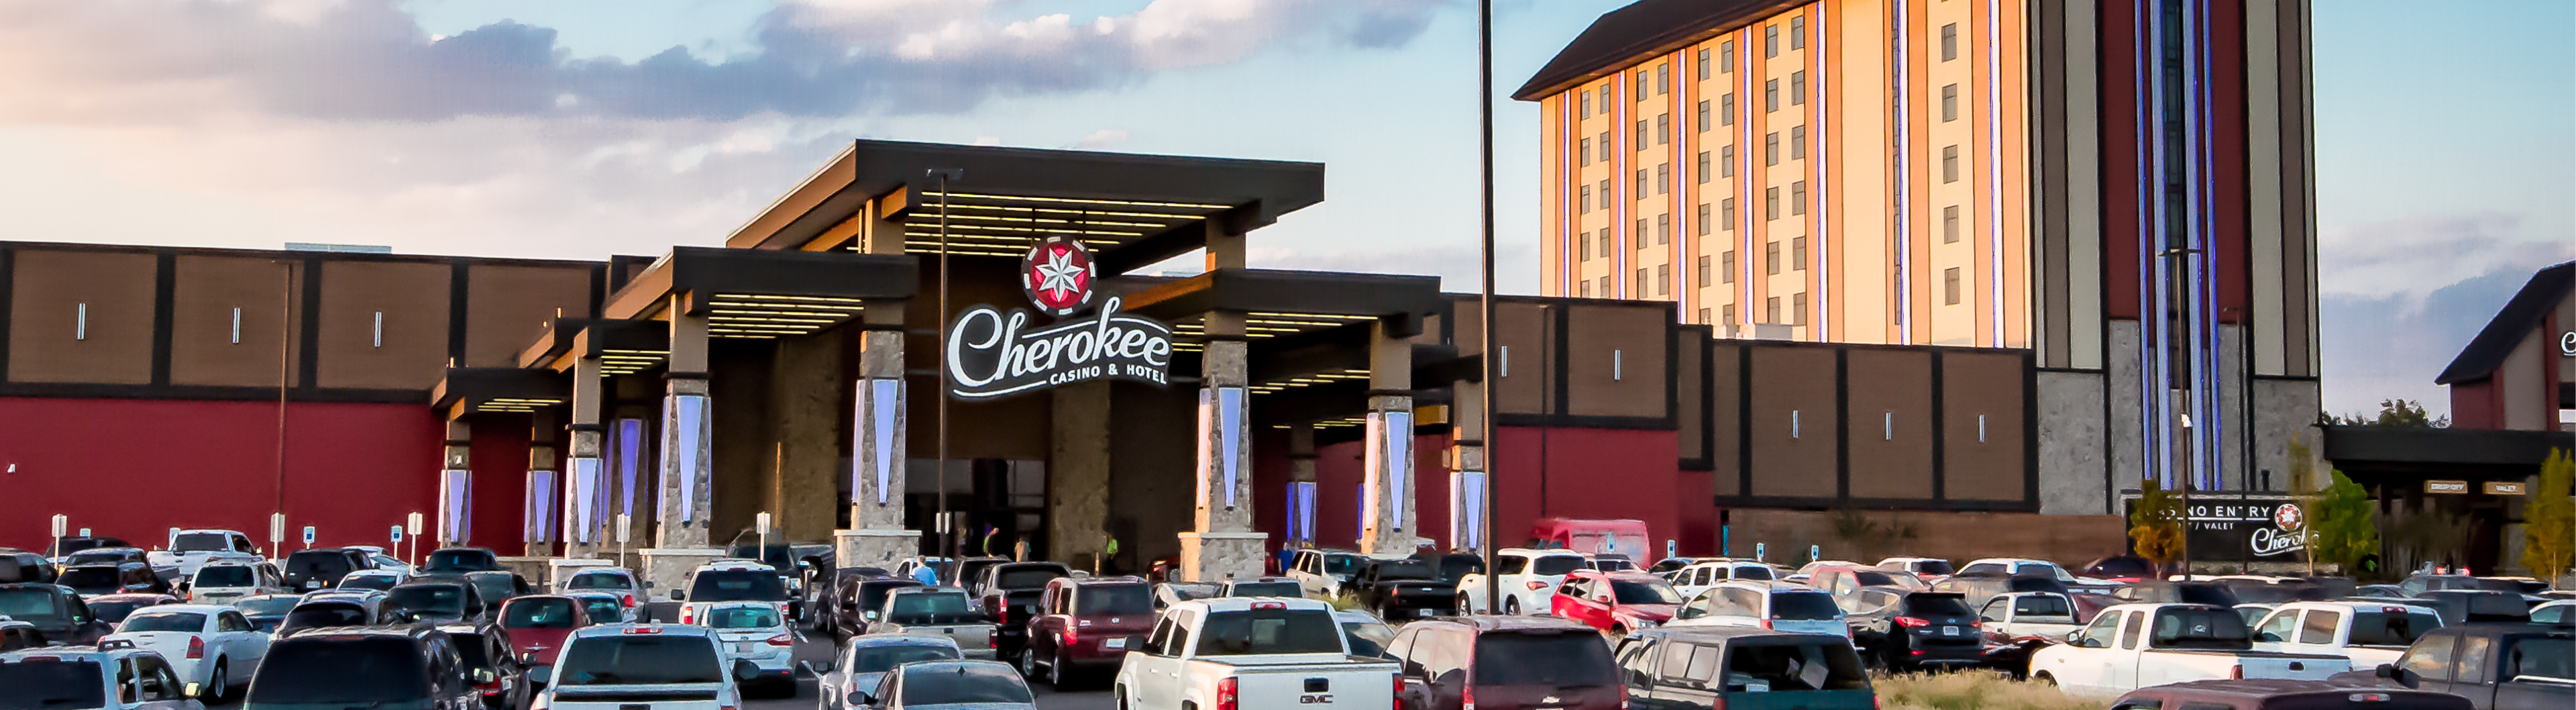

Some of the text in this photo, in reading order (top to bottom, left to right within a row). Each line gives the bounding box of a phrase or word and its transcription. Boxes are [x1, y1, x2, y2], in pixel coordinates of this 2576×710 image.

[947, 297, 1169, 387] Cherokee
[1050, 363, 1167, 385] CASINO & HOTEL
[2216, 506, 2269, 517] ENRY
[1300, 694, 1334, 703] GMC
